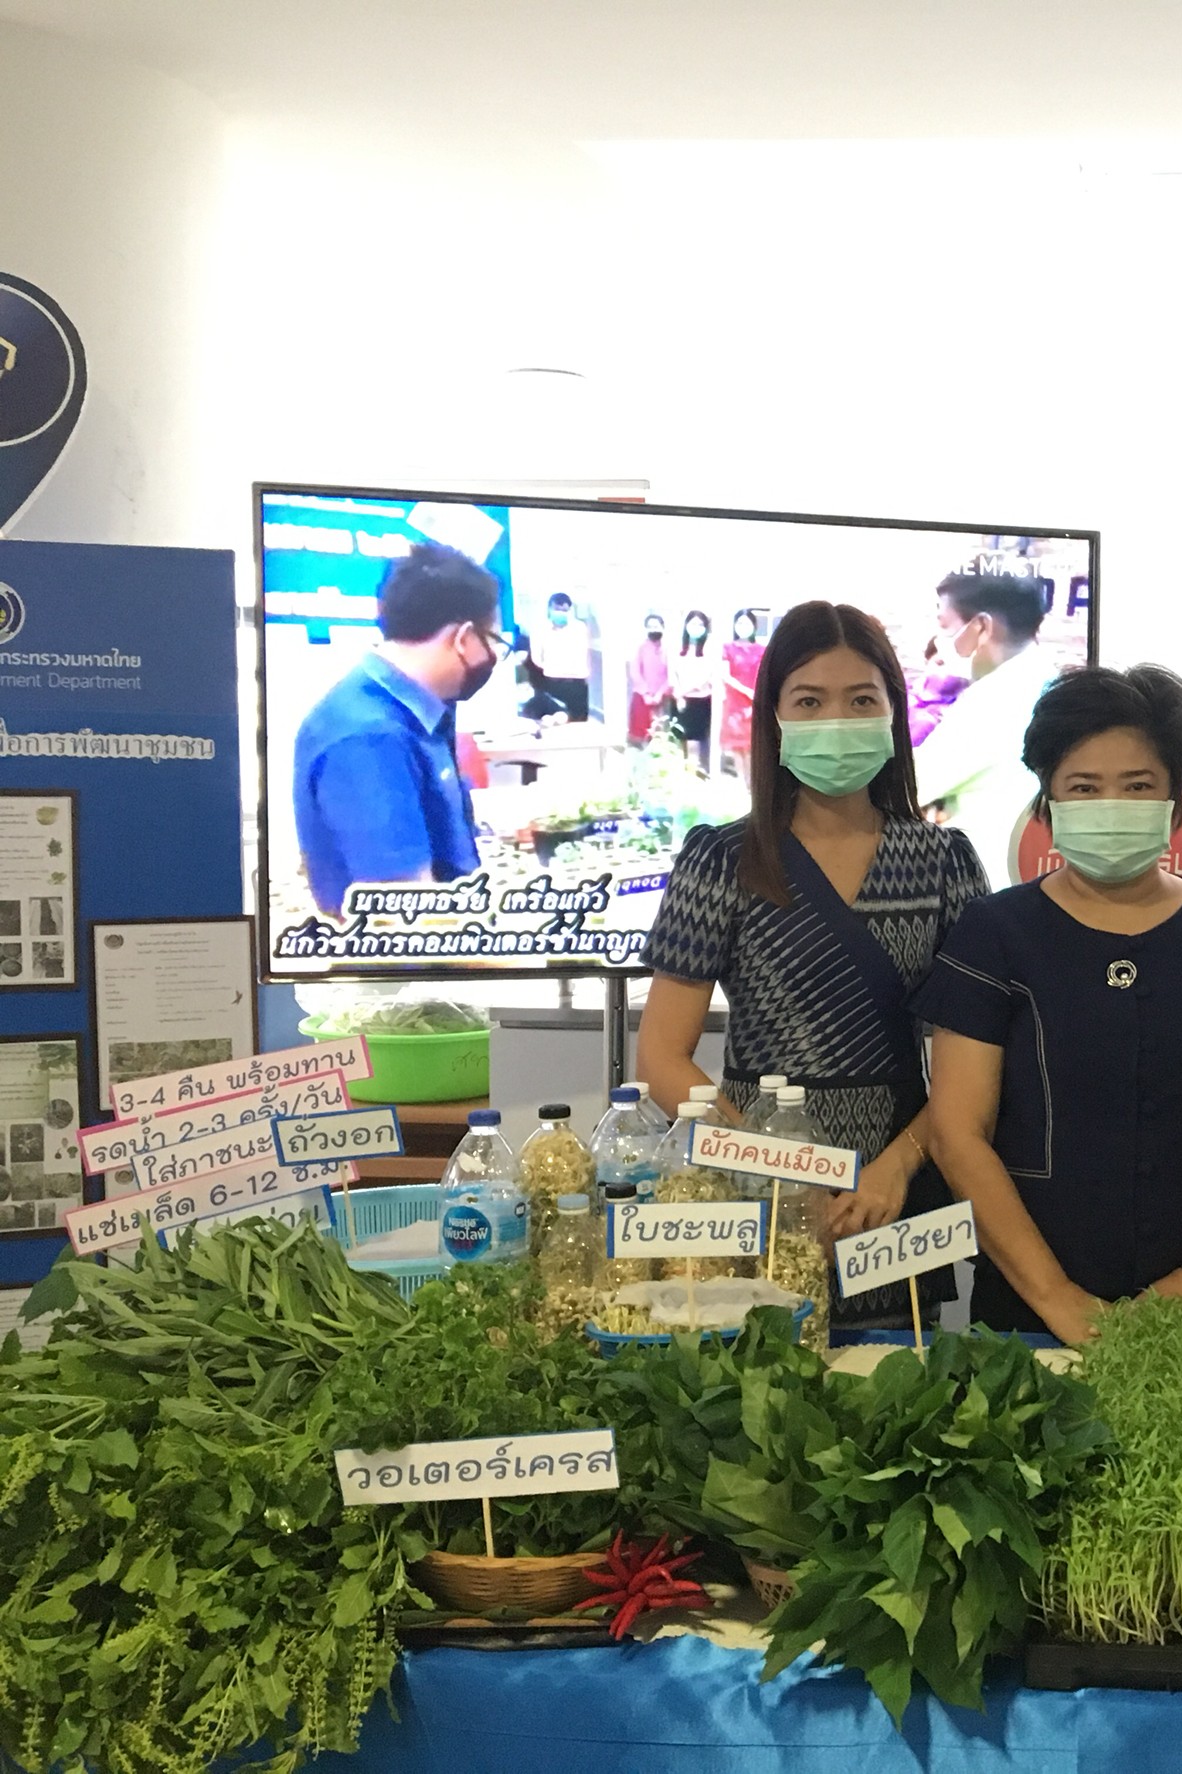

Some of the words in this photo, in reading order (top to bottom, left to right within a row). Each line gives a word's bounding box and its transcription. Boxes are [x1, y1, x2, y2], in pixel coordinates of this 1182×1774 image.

[49, 672, 142, 691] Department
[278, 919, 648, 962] นักวิชาการคอมพิวเตอร์ชำนาญก
[120, 1087, 166, 1113] 3-4
[178, 1073, 215, 1101] คืน
[226, 1049, 356, 1090] พร้อมทาน
[179, 1113, 226, 1143] 2-3
[700, 1129, 846, 1178] ผักคนเมือง
[210, 1170, 278, 1206] 6-12
[621, 1204, 758, 1253] ใบชะพลู
[846, 1219, 972, 1279] ผักไชยา
[347, 1441, 613, 1489] วอเตอร์เครส
